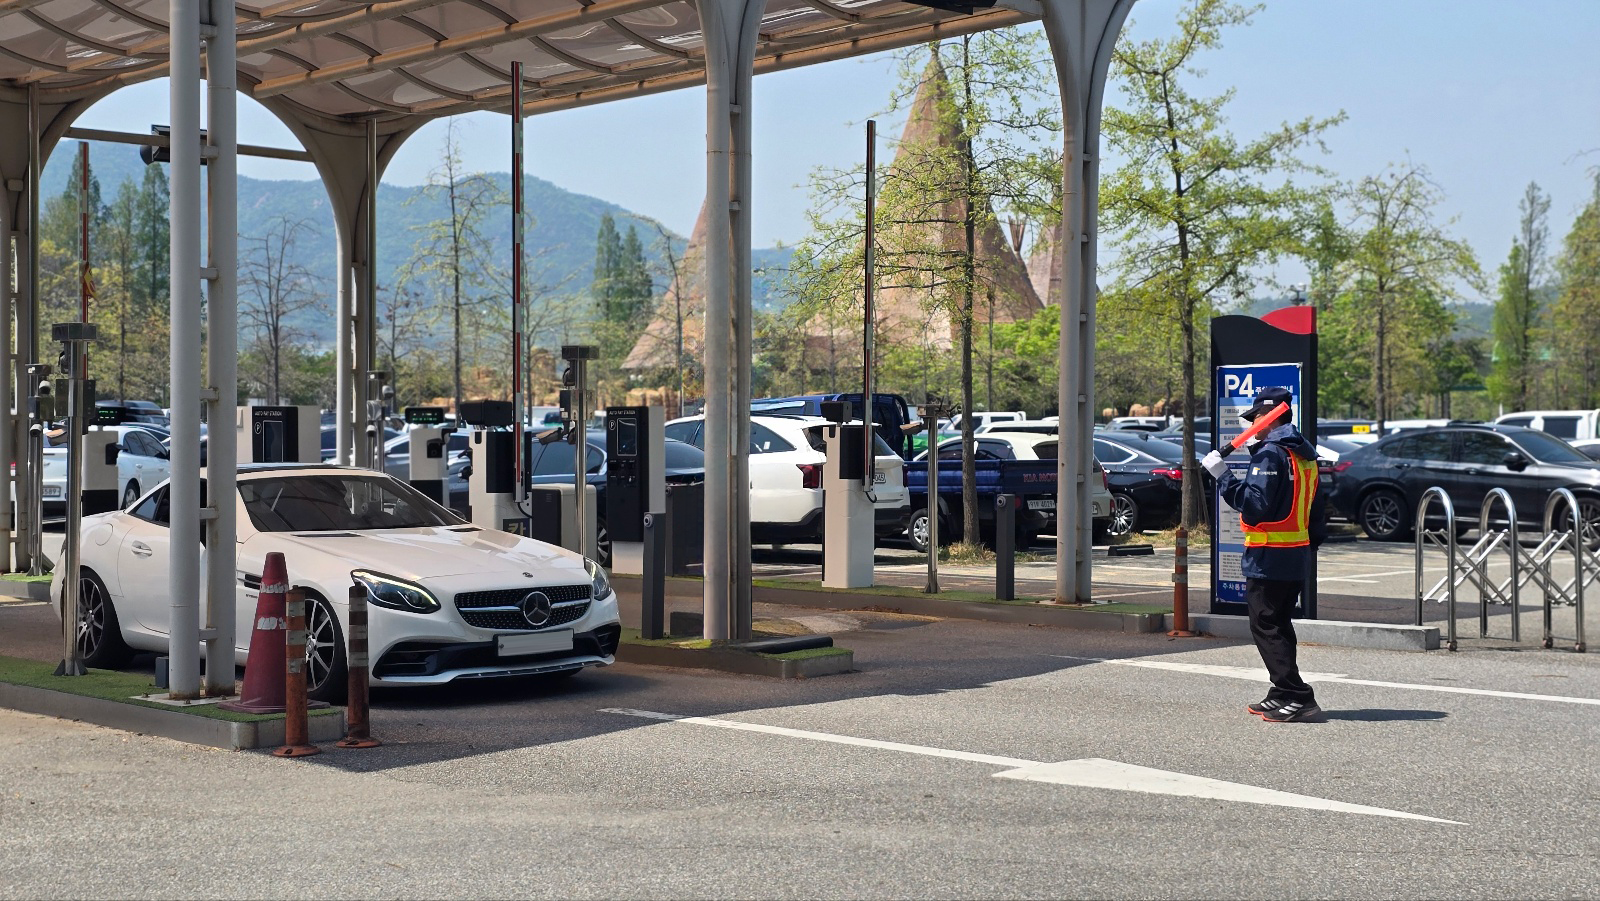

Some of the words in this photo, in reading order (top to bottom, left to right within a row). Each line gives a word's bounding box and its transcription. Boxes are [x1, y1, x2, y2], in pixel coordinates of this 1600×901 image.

[1224, 373, 1254, 398] P4
[1022, 473, 1038, 482] KIA
[1039, 473, 1058, 482] MOT
